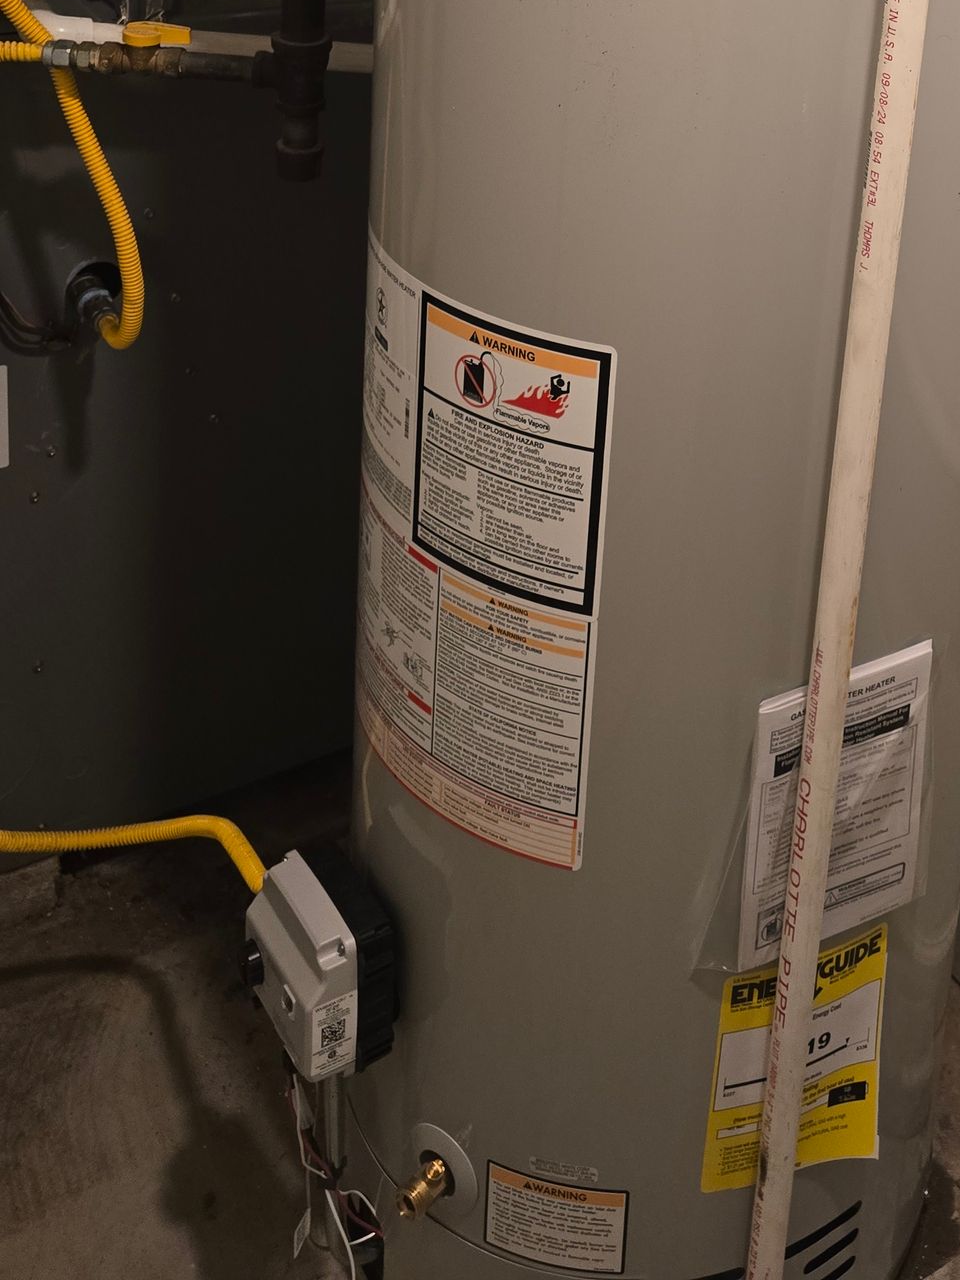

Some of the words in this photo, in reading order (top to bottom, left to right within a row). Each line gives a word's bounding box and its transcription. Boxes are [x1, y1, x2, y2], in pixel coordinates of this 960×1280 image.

[889, 8, 898, 23] IN
[883, 25, 896, 65] U.S.A.
[876, 73, 891, 124] 09/08/24
[872, 132, 884, 164] 08:54
[862, 220, 874, 258] THOMAS
[483, 335, 535, 361] WARNING
[465, 416, 477, 426] AND
[479, 421, 514, 441] EXPLOSION
[516, 435, 544, 449] HAZARD
[495, 408, 527, 424] Flammable
[528, 418, 550, 431] Vapors
[497, 601, 528, 616] WARNING
[496, 628, 527, 643] WARNING
[848, 688, 864, 698] TER
[865, 676, 896, 694] HEATER
[783, 776, 811, 942] CHARLOTTE
[776, 954, 791, 1029] PIPE
[531, 1182, 587, 1202] WARNING
